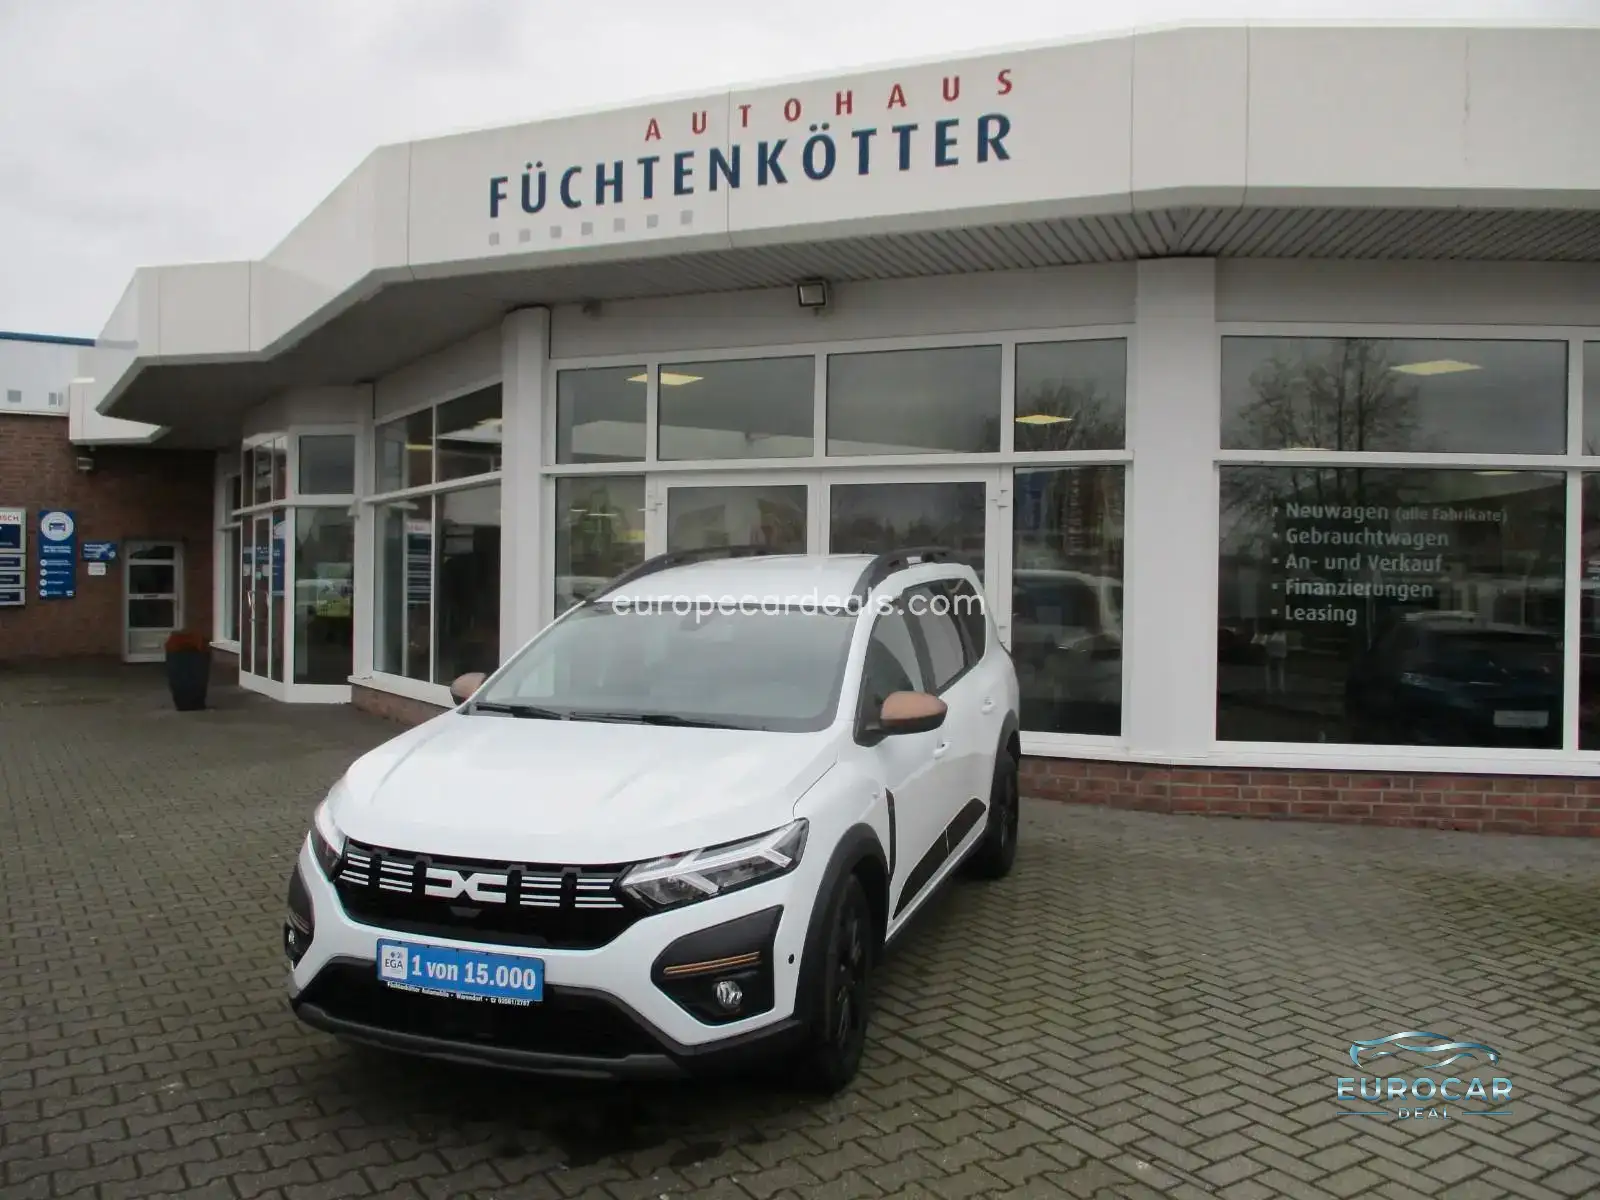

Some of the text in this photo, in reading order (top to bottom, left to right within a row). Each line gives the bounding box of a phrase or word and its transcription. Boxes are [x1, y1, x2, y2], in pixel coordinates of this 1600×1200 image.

[644, 69, 1014, 142] AUTOHAUS
[488, 113, 1013, 219] FÜCHTENKÖTTER
[1285, 503, 1389, 523] Neuwagen
[1285, 528, 1450, 551] Gebrauchtwagen
[1285, 553, 1444, 573] An- und Verkauf
[1285, 578, 1434, 602] Finanzierungen
[1285, 603, 1358, 626] Leasing
[384, 958, 404, 969] EGA
[411, 954, 536, 991] 1 von 15.000
